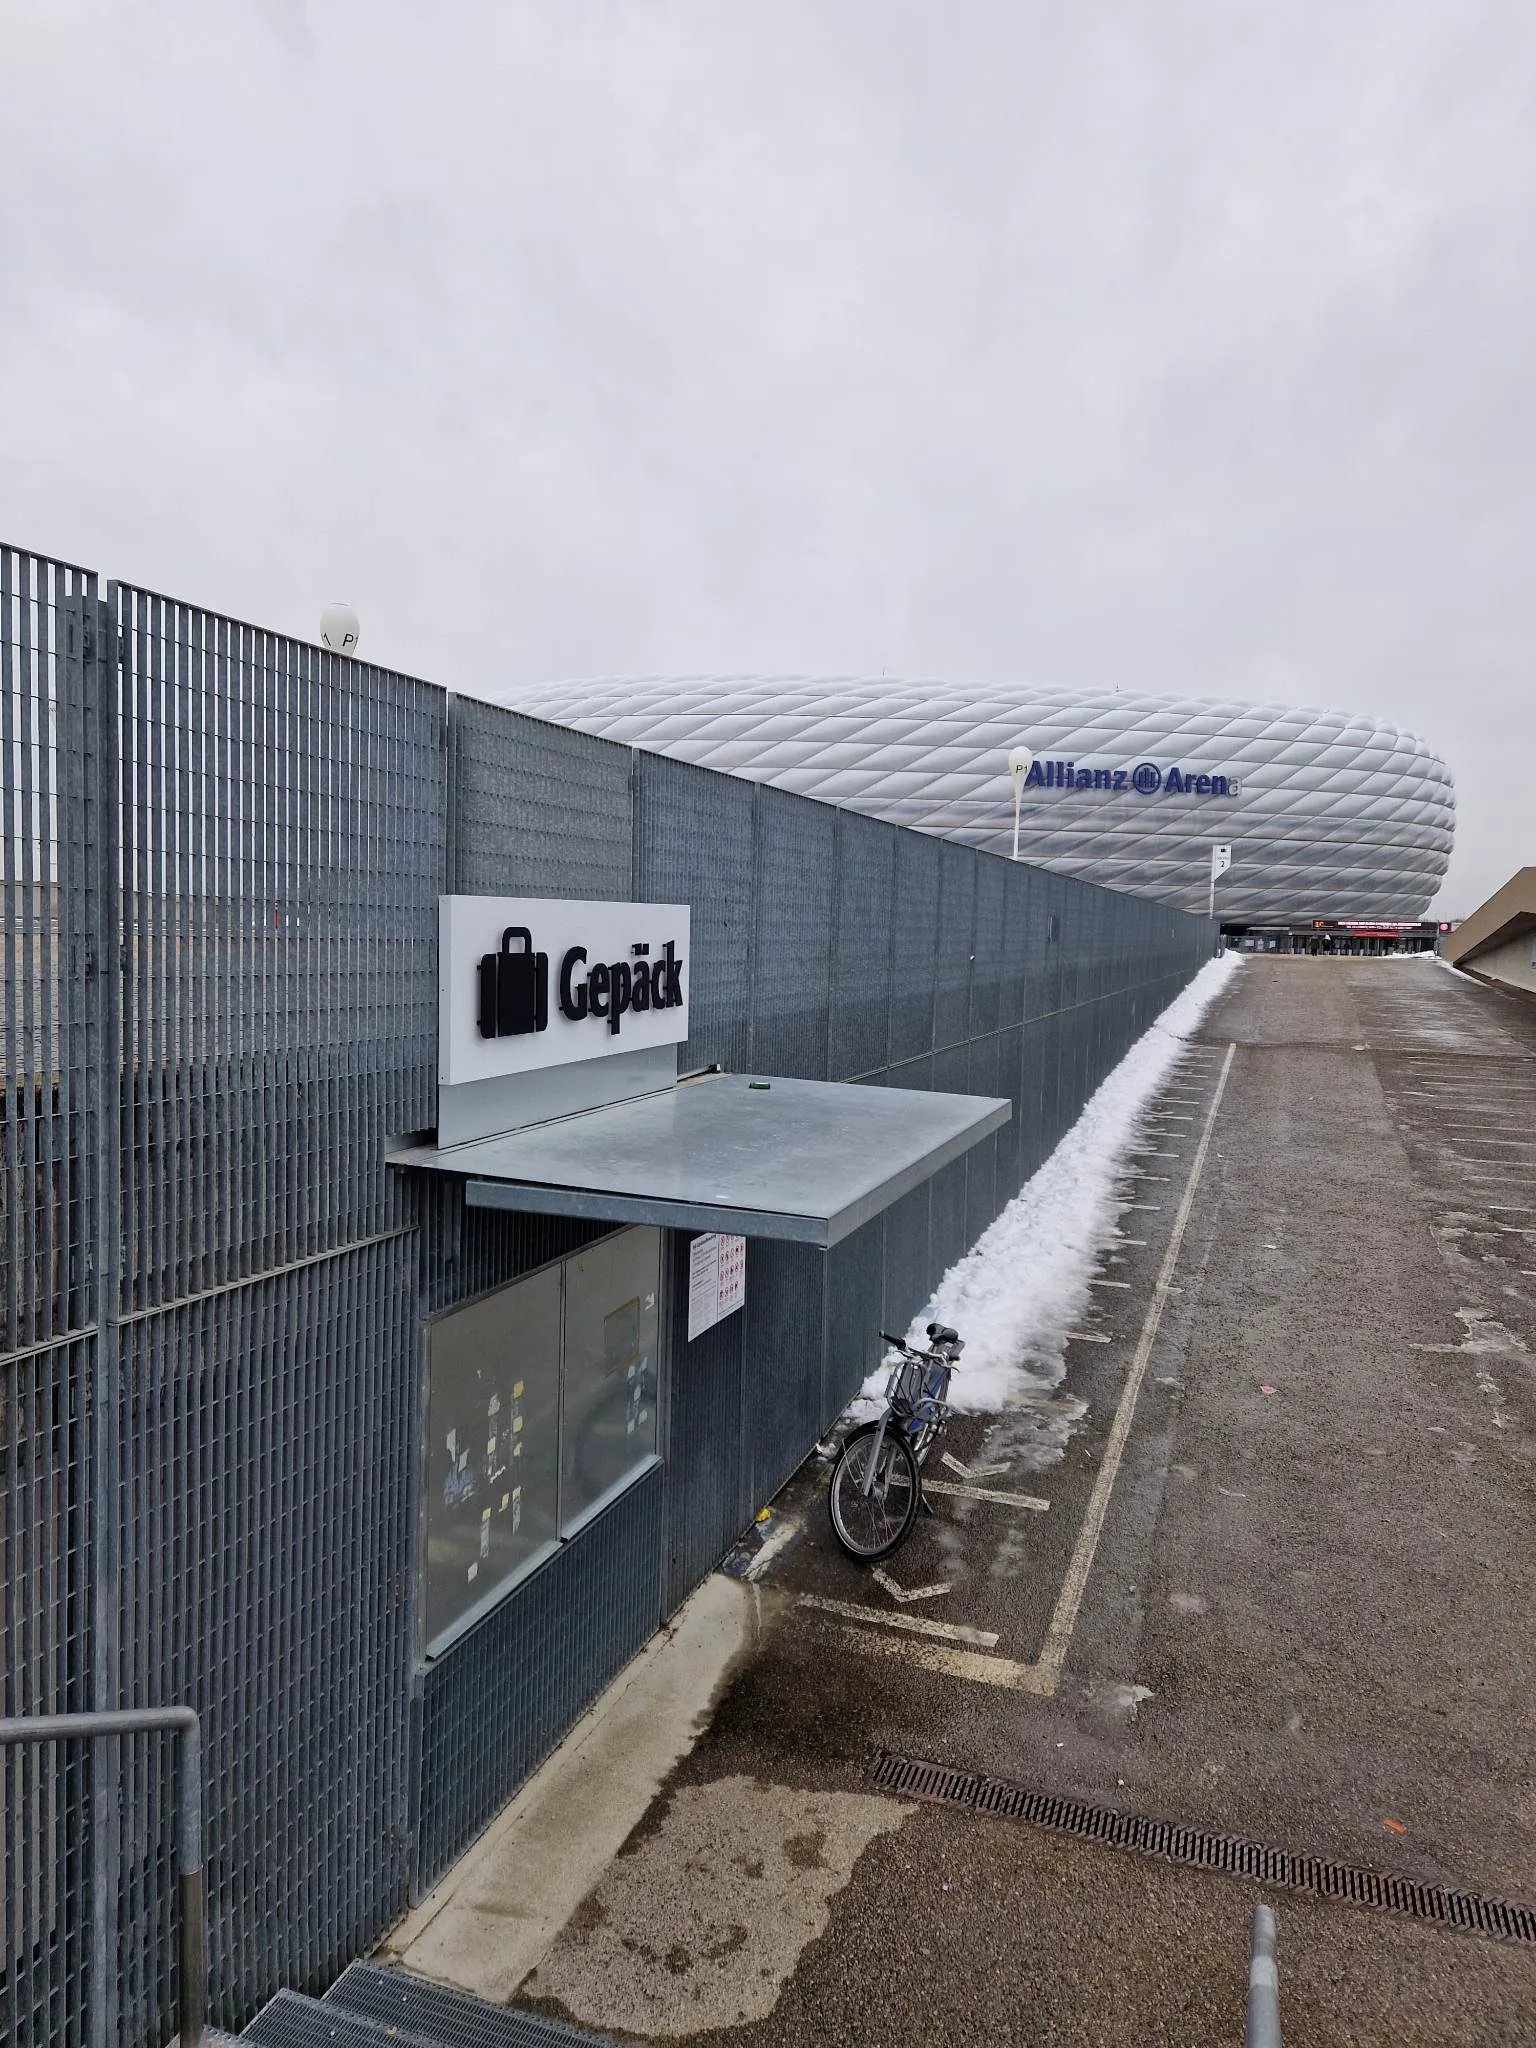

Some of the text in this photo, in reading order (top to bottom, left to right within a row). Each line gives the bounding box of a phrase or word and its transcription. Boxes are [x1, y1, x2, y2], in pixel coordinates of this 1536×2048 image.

[1015, 764, 1028, 775] P1
[1023, 760, 1242, 797] Allianz Arena
[559, 940, 684, 1036] Gepäck
